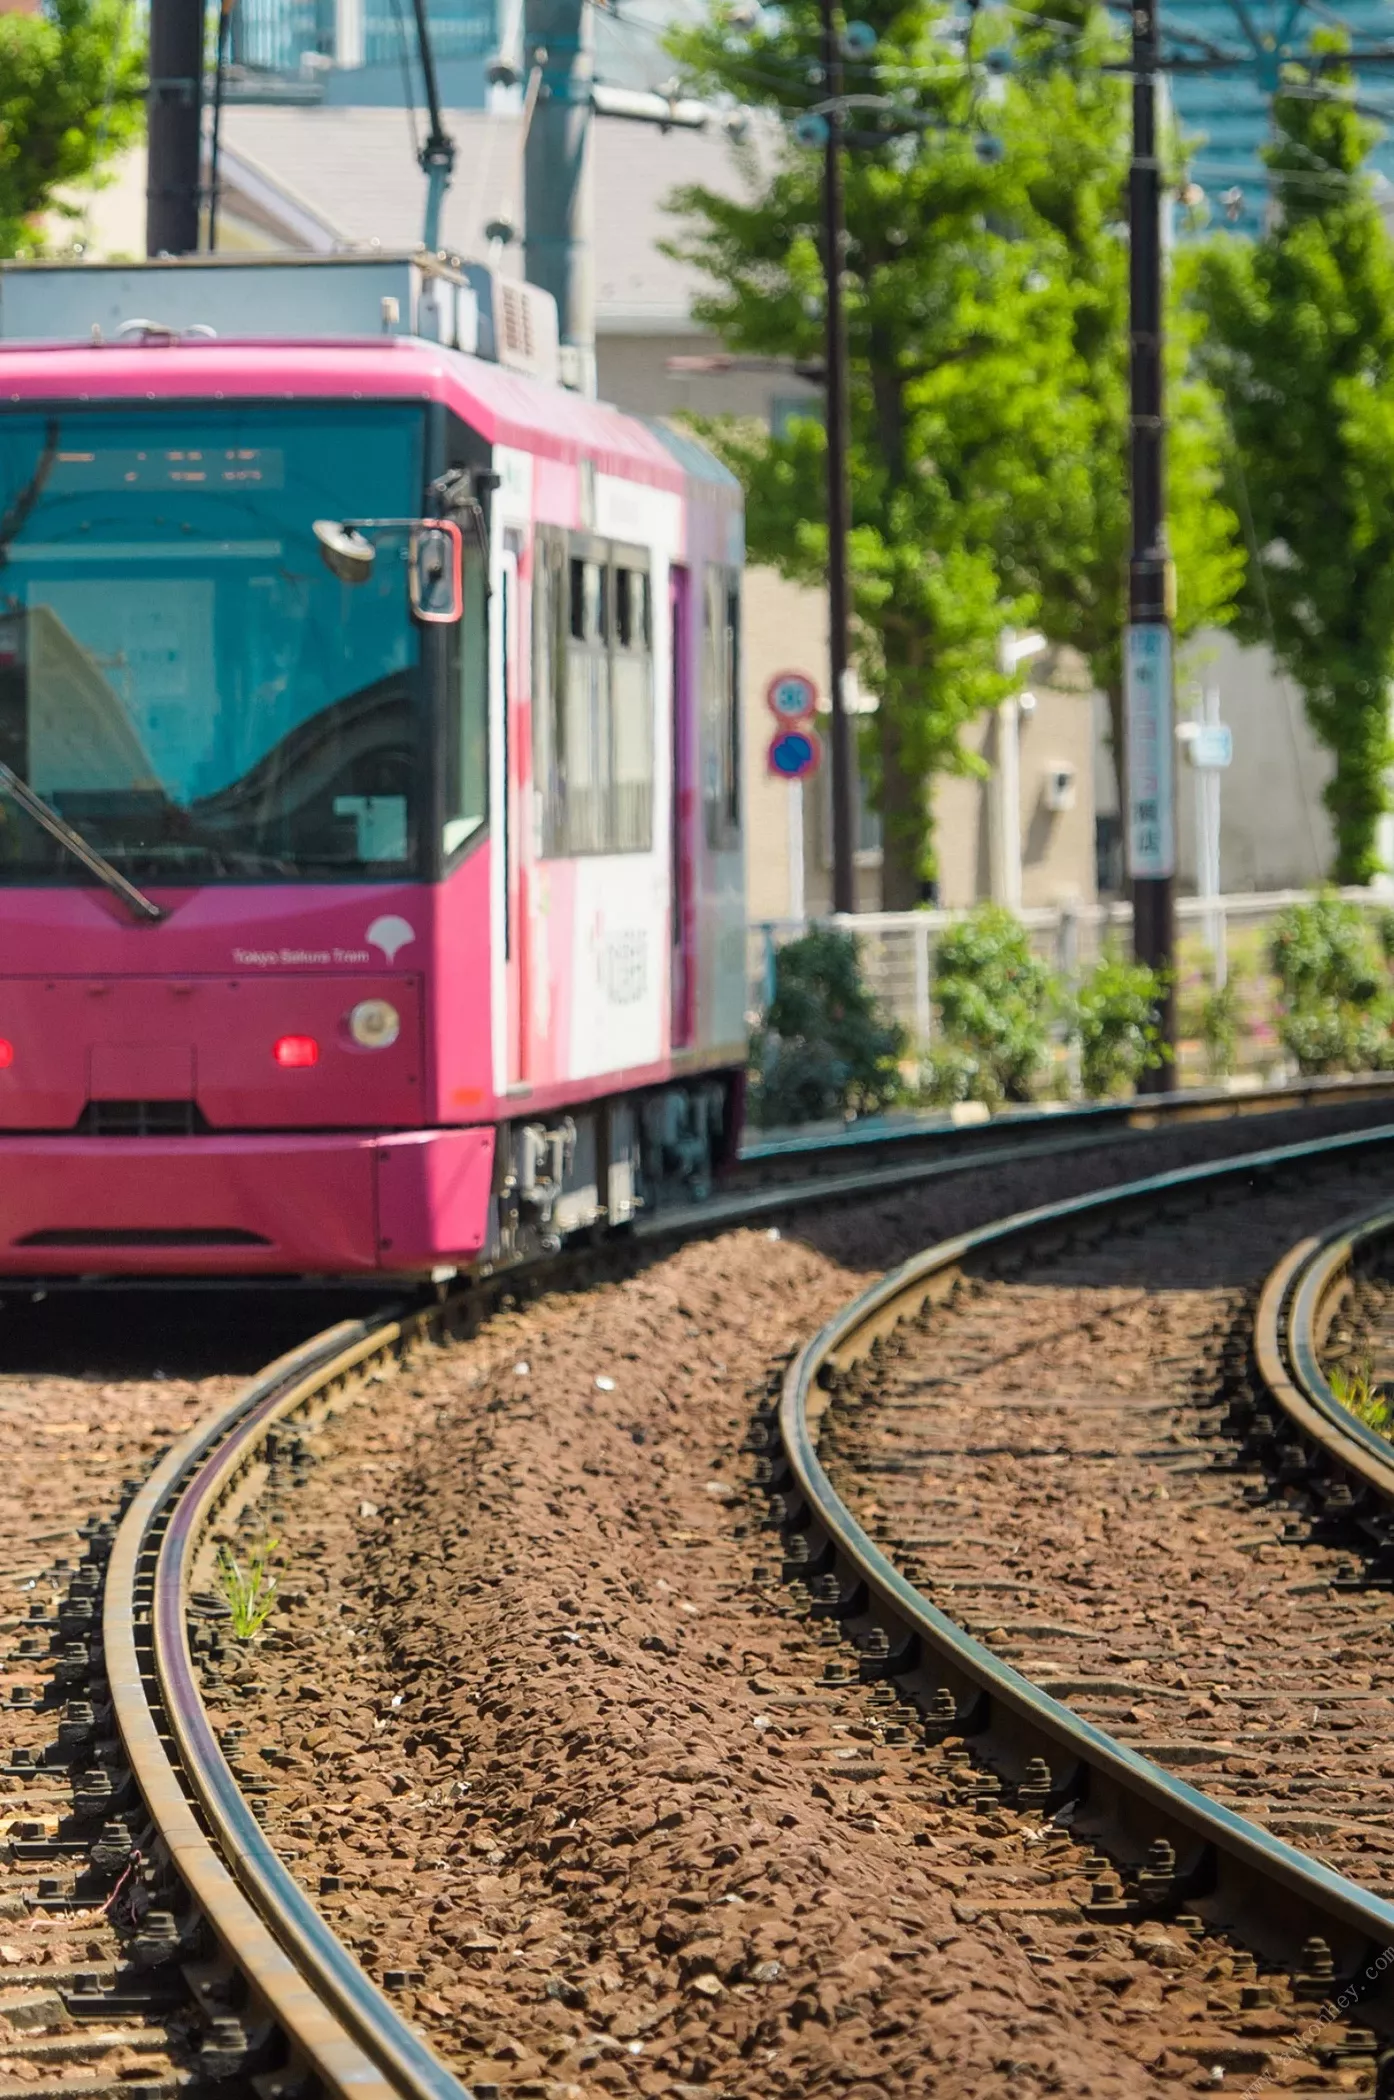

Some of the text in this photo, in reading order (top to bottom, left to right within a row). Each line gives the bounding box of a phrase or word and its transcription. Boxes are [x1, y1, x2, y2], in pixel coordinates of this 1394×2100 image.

[232, 948, 369, 967] Tokyo Sakura Tram
